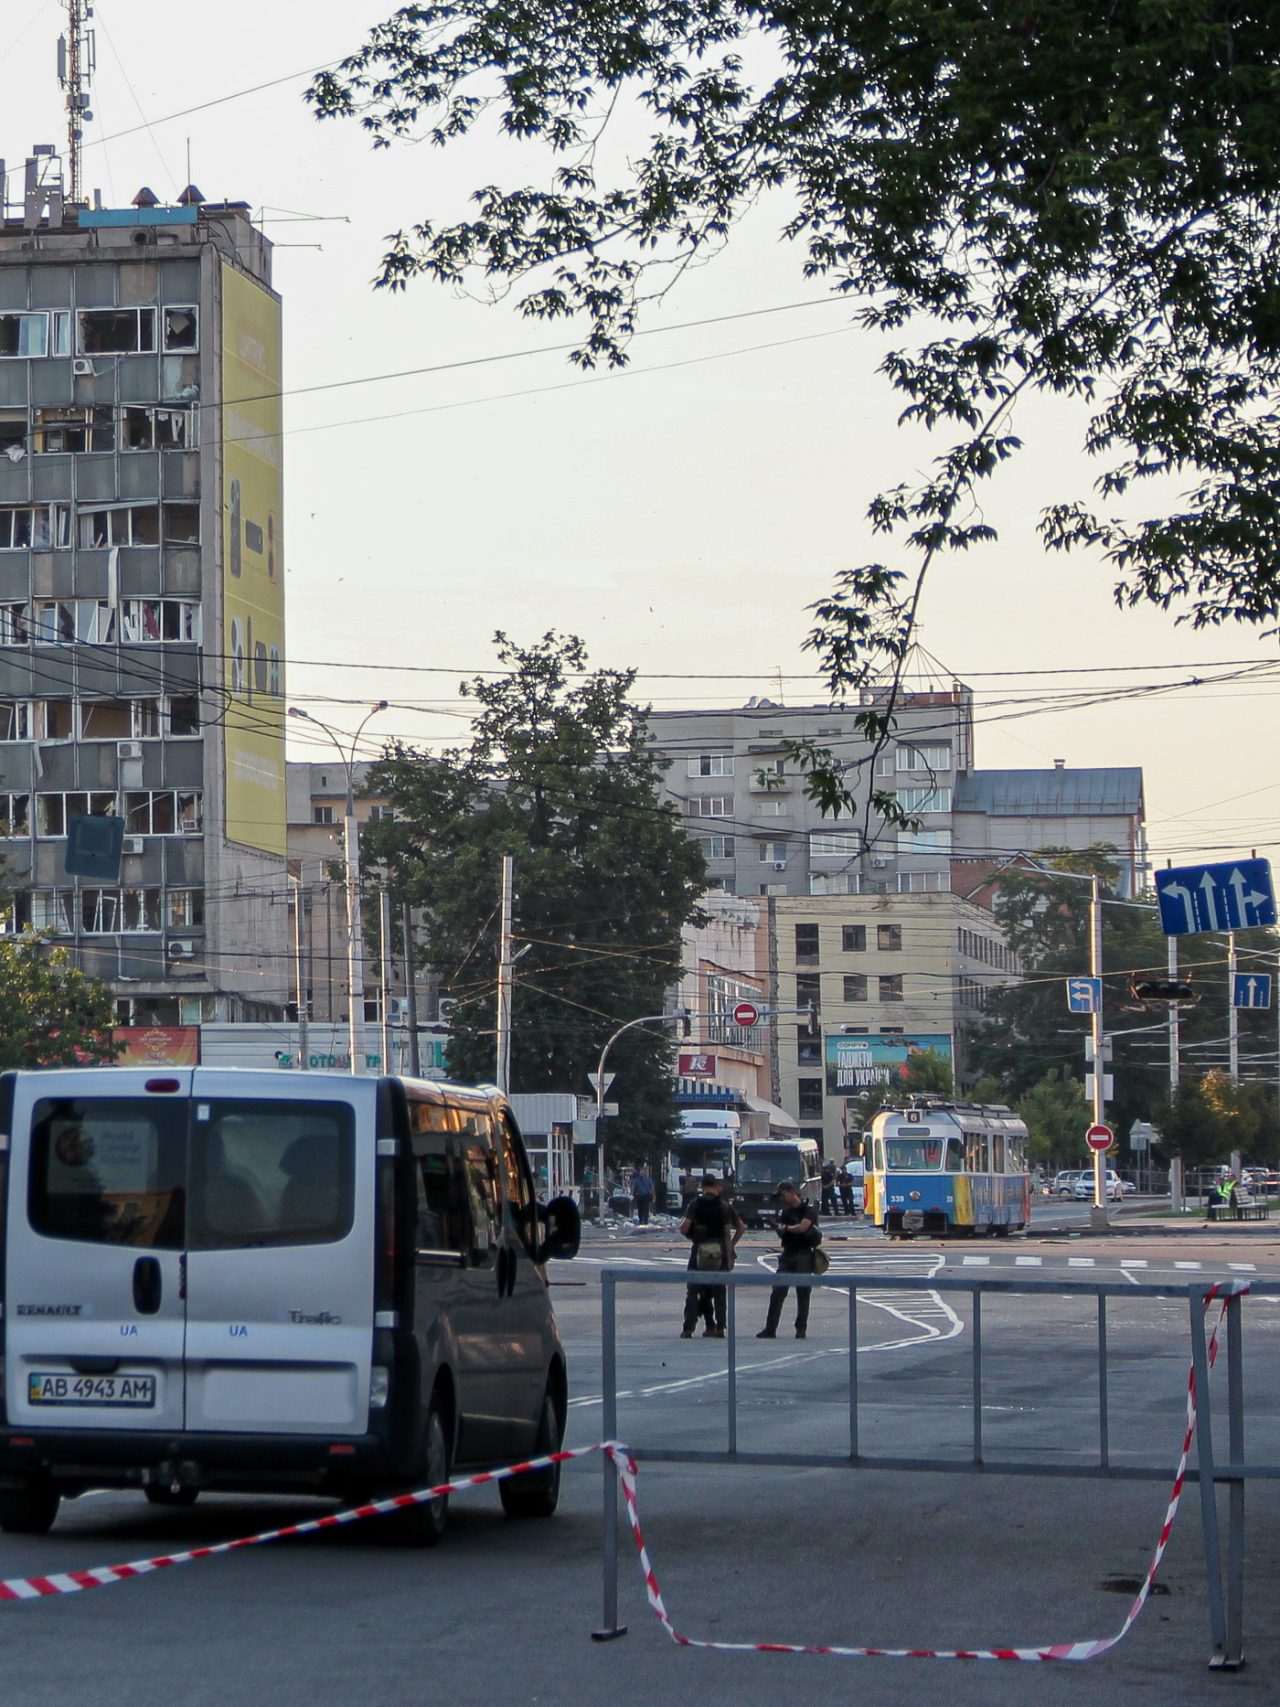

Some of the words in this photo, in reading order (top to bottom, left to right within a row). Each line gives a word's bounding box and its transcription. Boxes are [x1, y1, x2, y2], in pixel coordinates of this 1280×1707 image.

[837, 1051, 872, 1068] ГАДЖЕТИ
[836, 1069, 854, 1087] ДЛЯ
[855, 1067, 890, 1086] УКРАЇНИ
[910, 1113, 917, 1122] 6
[16, 1304, 82, 1317] RENAULT
[288, 1309, 342, 1326] Trafic
[120, 1325, 138, 1337] UA
[229, 1325, 248, 1338] UA
[42, 1377, 68, 1398] AB
[73, 1378, 116, 1398] 4943
[120, 1379, 148, 1398] AM
